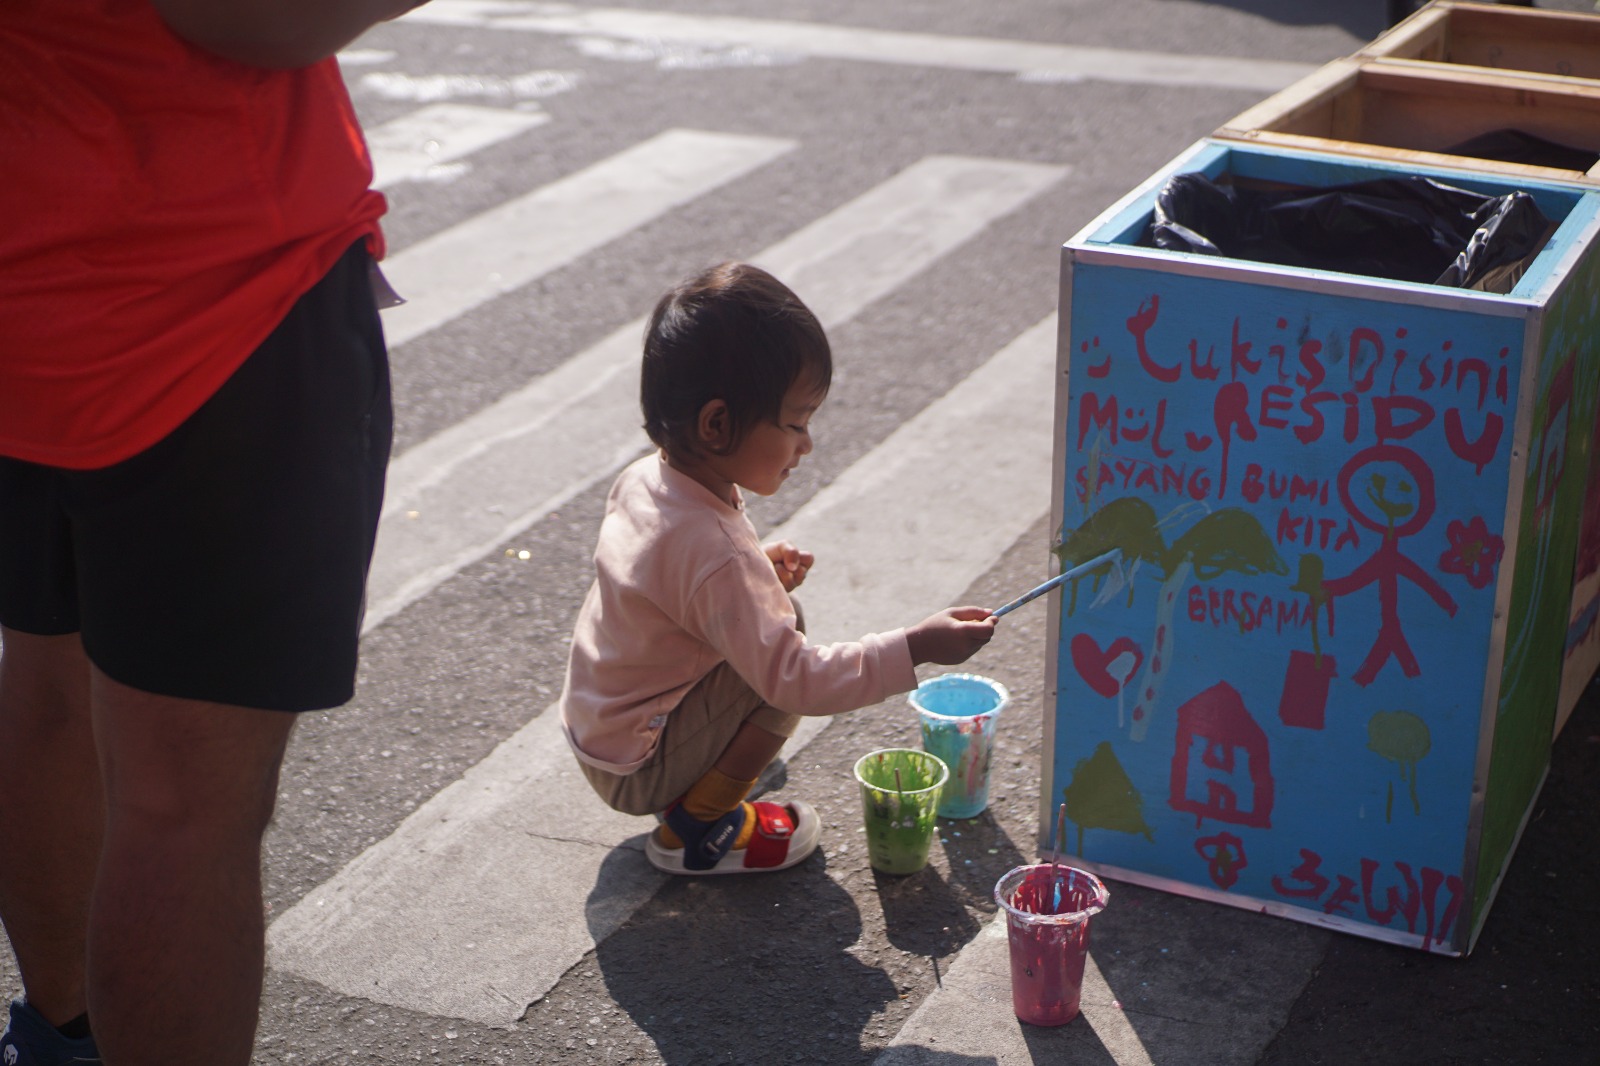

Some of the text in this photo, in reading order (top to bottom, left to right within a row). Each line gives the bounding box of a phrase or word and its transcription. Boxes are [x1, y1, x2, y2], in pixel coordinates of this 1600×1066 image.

[1348, 327, 1510, 410] Disini
[1075, 461, 1329, 505] SAYANG BUMI
[1277, 507, 1360, 551] KITA
